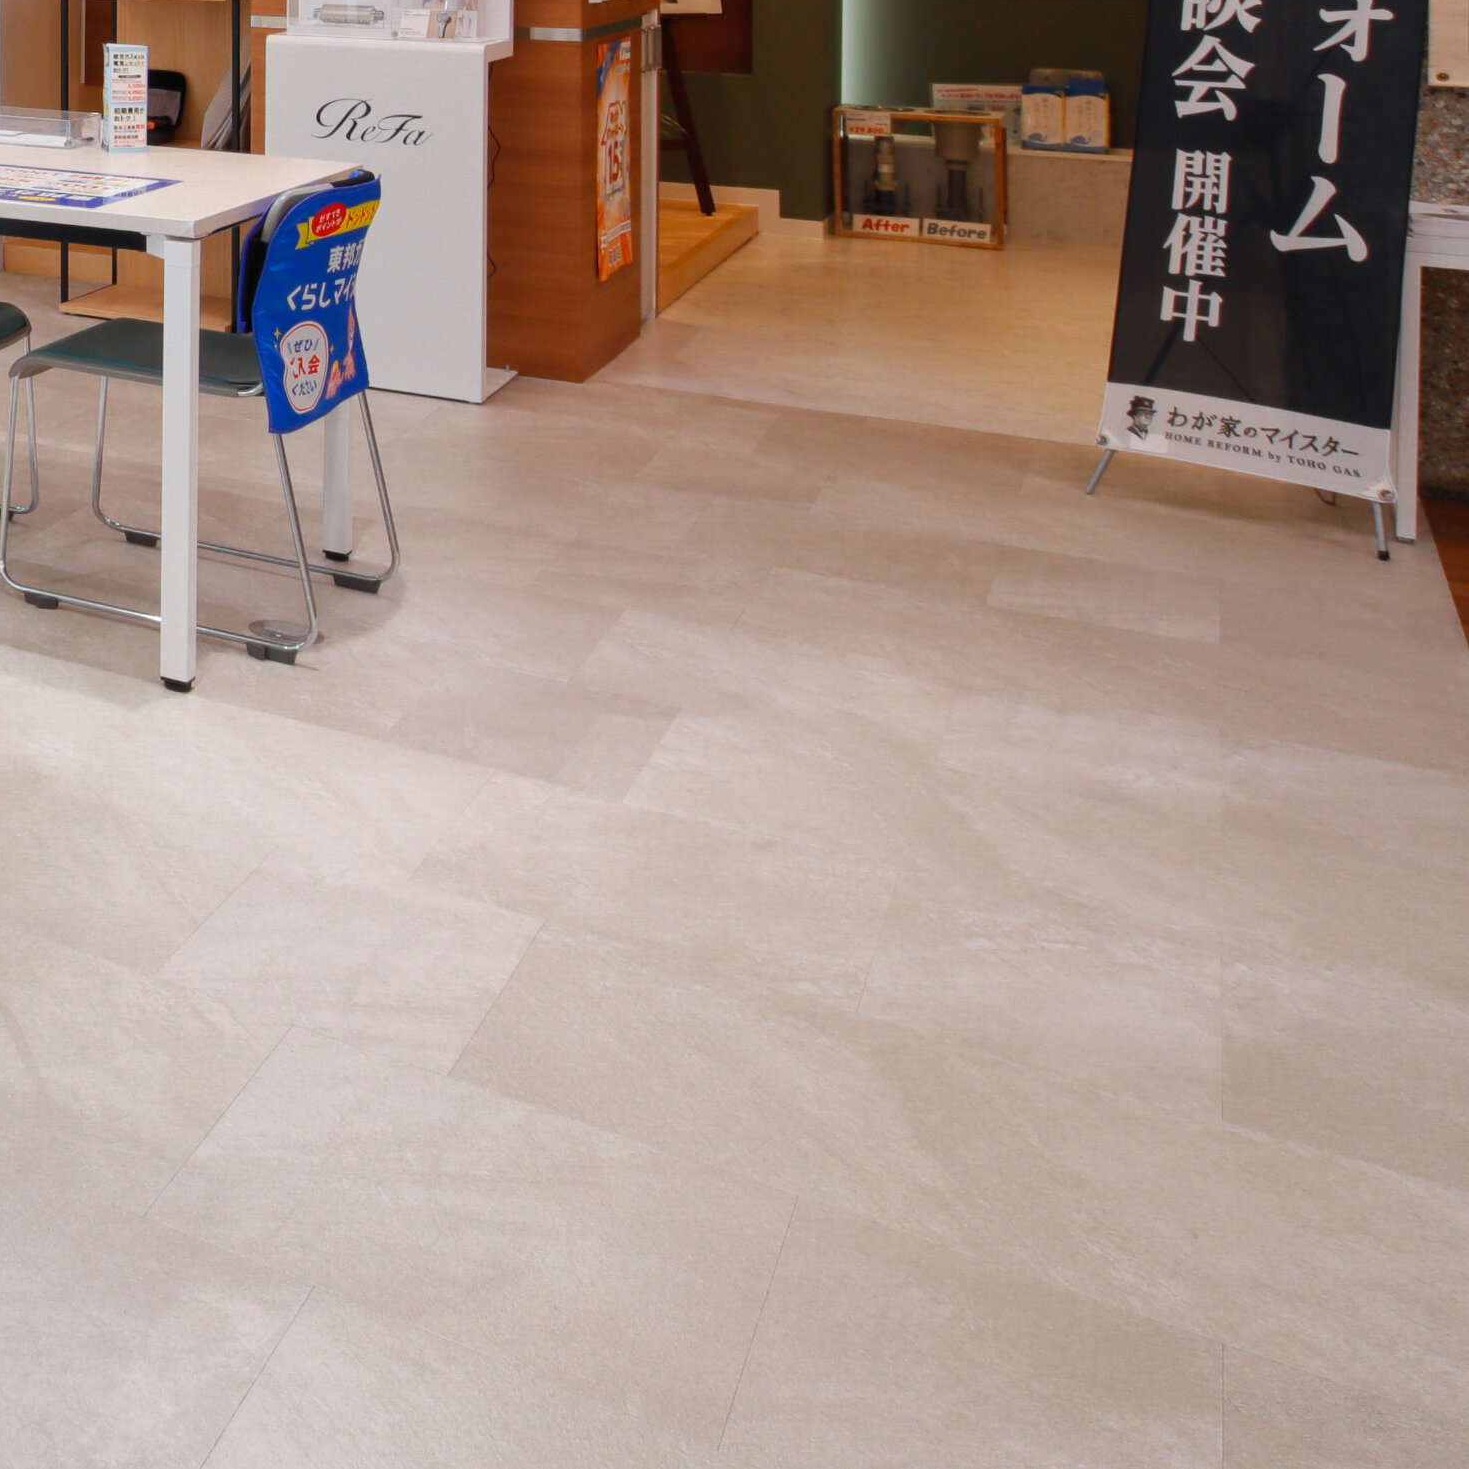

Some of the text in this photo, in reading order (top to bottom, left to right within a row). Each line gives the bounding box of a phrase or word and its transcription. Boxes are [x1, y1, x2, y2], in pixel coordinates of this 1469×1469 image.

[315, 98, 435, 147] ReFa
[315, 217, 343, 233] ポイントが
[319, 208, 342, 224] がすてき
[862, 217, 911, 233] After
[926, 222, 988, 240] Before
[1160, 148, 1232, 343] 開催中
[294, 338, 313, 353] ぜひ
[1167, 406, 1361, 458] わが家のマイスター
[1164, 431, 1362, 479] HOME REFORM by TOHO GAS
